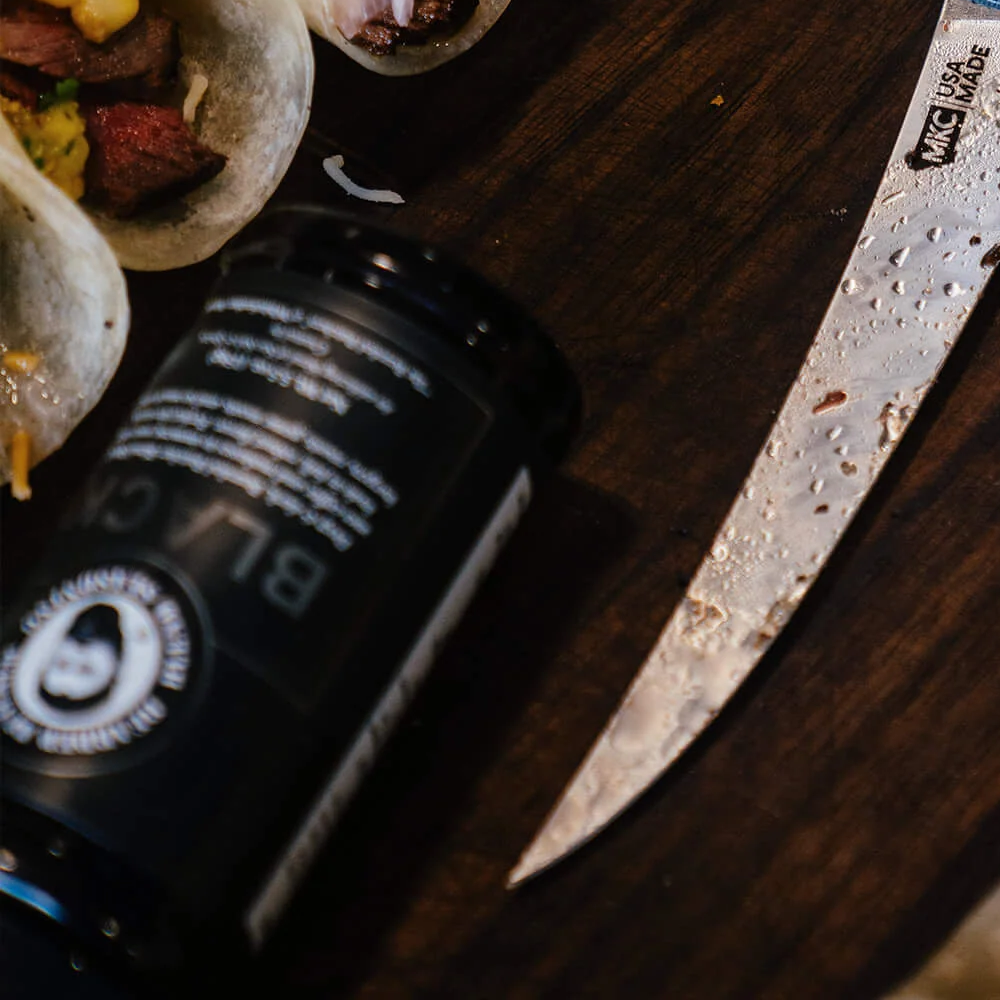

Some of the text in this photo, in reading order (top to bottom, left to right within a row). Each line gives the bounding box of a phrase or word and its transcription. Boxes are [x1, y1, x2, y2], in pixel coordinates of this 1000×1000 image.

[936, 61, 965, 97] USA
[955, 45, 990, 103] MADE
[921, 110, 958, 163] MKC
